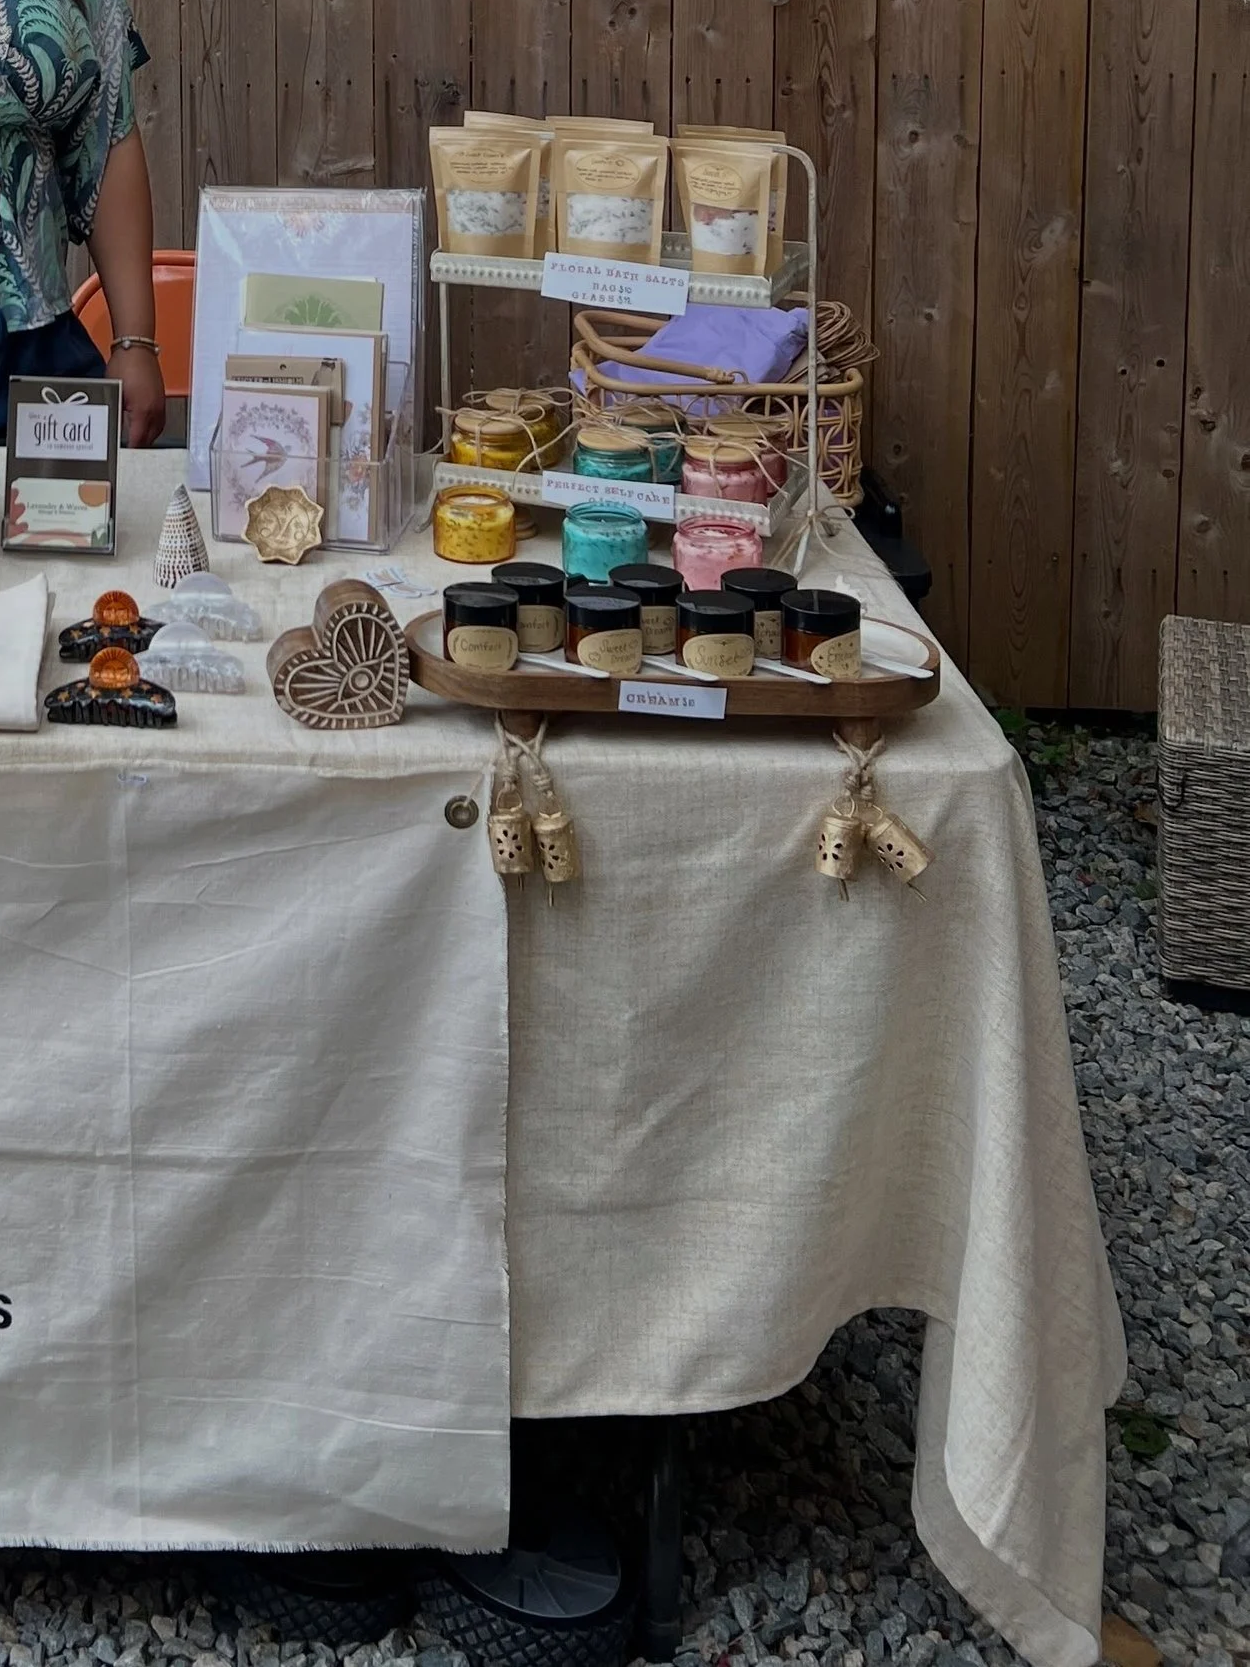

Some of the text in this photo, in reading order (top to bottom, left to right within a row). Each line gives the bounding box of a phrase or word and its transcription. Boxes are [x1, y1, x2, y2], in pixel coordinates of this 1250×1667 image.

[550, 262, 685, 287] FLORAL BATH SALTS
[571, 291, 615, 303] GLASS
[33, 413, 92, 447] gift card
[546, 478, 670, 505] PERFECT SELF CARE
[599, 638, 628, 654] Sweet
[694, 644, 745, 669] Sunset
